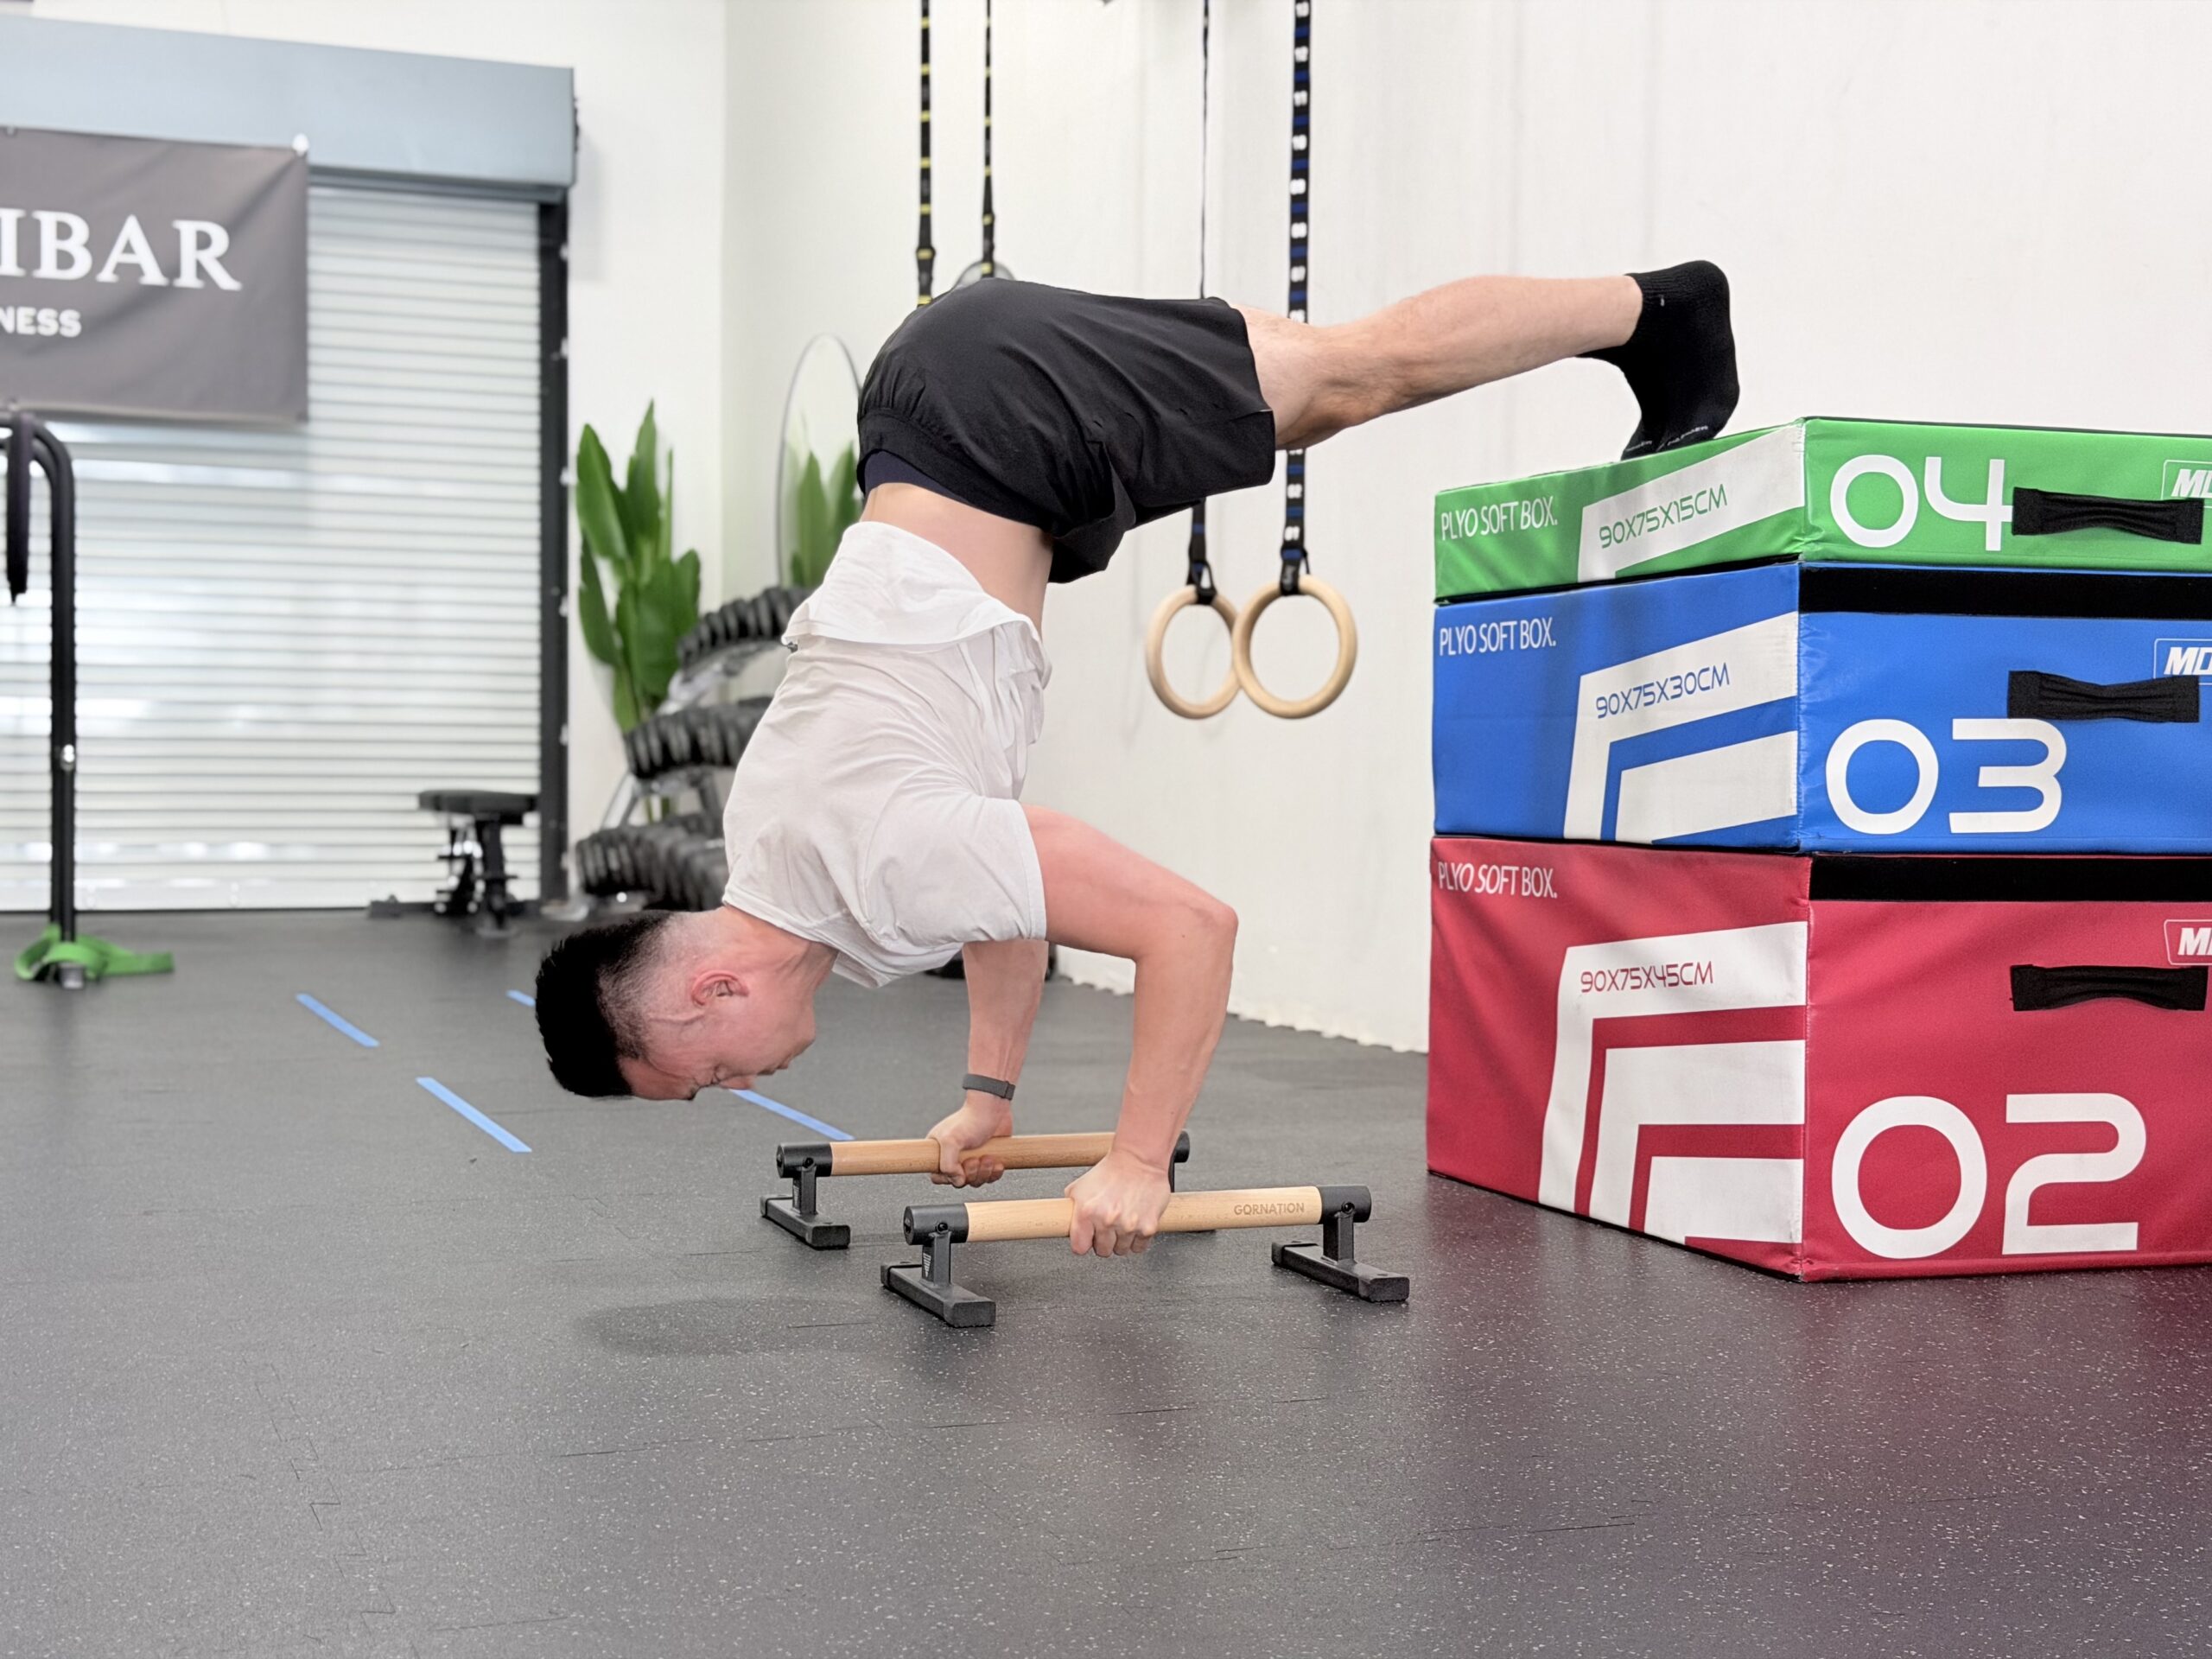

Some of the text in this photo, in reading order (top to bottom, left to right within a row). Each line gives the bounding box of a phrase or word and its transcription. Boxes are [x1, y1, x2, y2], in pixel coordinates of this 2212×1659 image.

[0, 306, 82, 338] NESS
[1441, 496, 1558, 541] PLYO SOFT BOX.
[1599, 483, 1728, 550] 90X75X15CM
[1830, 454, 2013, 551] 04
[1440, 616, 1557, 656] PLYO SOFT BOX.
[1596, 662, 1730, 719] 90X75X30CM
[1826, 718, 2067, 835] 03
[1438, 861, 1558, 899] PLYO SOFT BOX.
[2177, 927, 2212, 956] M
[1580, 961, 1714, 994] 90X75X45CM
[1831, 1092, 2146, 1259] 02
